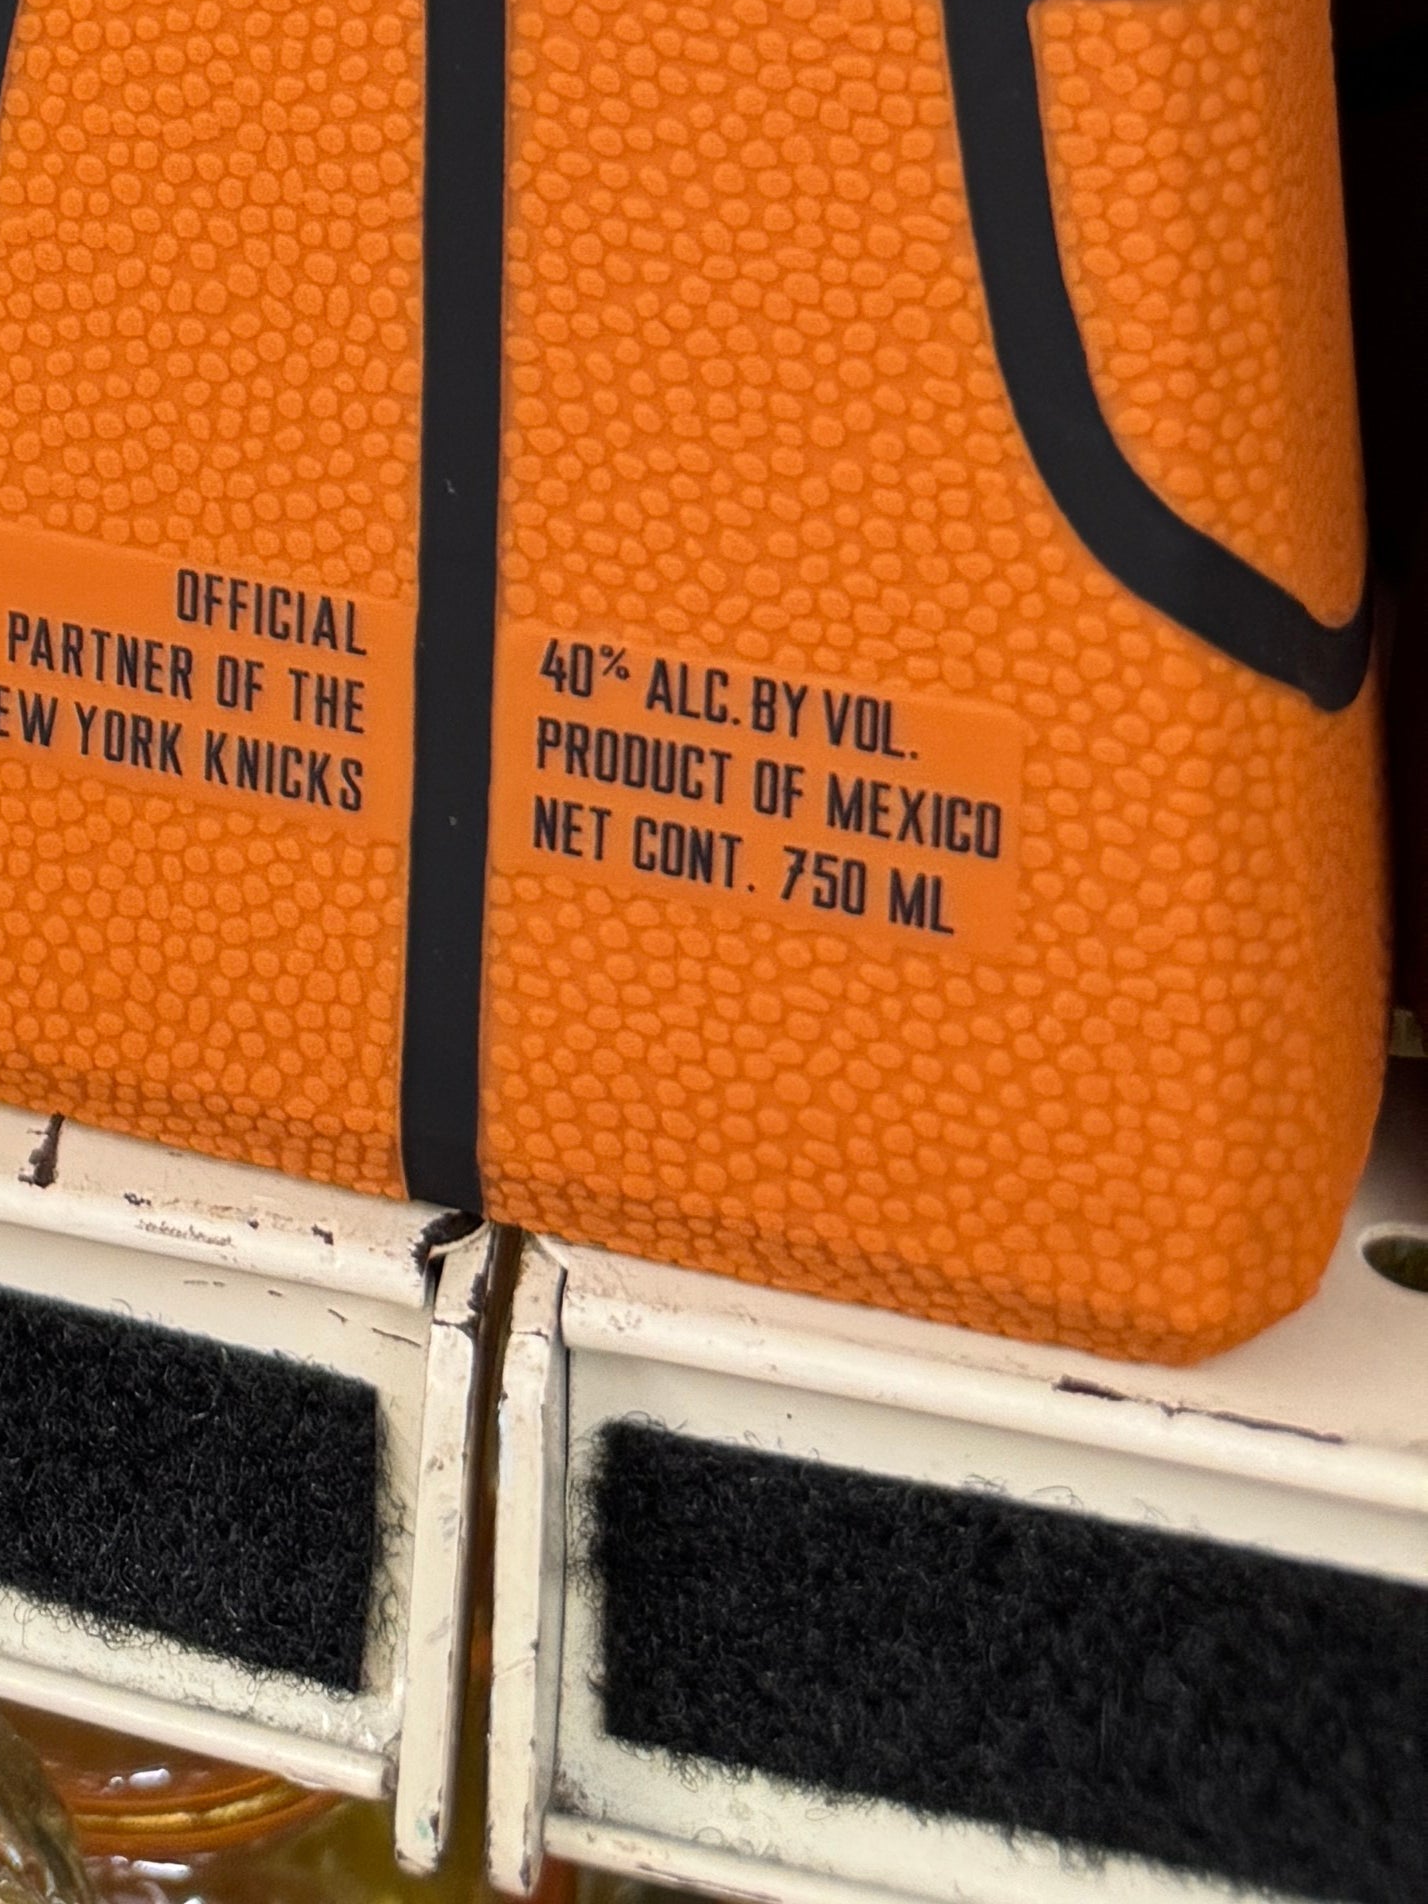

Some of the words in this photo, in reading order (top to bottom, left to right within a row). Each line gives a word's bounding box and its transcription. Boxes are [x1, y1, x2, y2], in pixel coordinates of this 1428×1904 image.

[177, 568, 366, 655] OFFICIAL
[7, 612, 194, 701] PARTNER
[217, 654, 265, 710] OF
[288, 669, 365, 735] THE
[540, 639, 631, 699] 40%
[822, 690, 920, 761] VOL.
[74, 702, 181, 775] YORK
[204, 729, 363, 813] KNICKS
[536, 715, 730, 806] PRODUCT
[753, 758, 805, 818] OF
[826, 773, 1002, 861] MEXICO
[533, 795, 612, 861] NET
[780, 847, 866, 917] 750
[889, 872, 954, 937] ML
